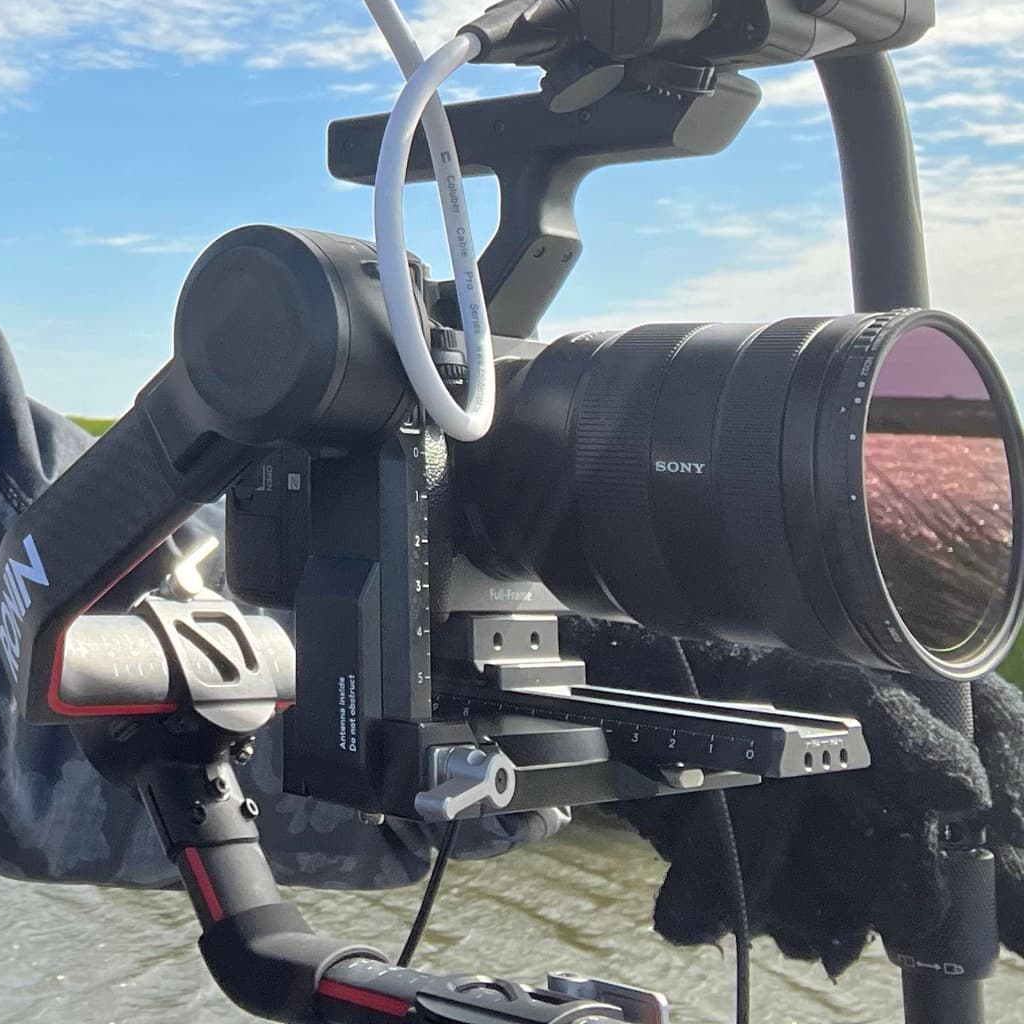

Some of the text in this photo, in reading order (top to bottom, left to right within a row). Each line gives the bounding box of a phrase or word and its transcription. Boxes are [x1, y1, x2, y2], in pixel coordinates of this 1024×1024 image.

[456, 227, 467, 257] Cable
[464, 271, 475, 290] Pro
[413, 448, 419, 458] 0
[655, 461, 706, 474] SONY
[414, 491, 419, 503] 1
[414, 536, 421, 547] 2
[415, 580, 422, 592] 3
[0, 533, 50, 684] RONIN
[416, 627, 423, 637] 4
[417, 672, 424, 684] 5
[348, 674, 356, 716] obstruct
[349, 737, 357, 752] Do
[631, 733, 639, 743] 3
[668, 738, 677, 748] 2
[709, 743, 713, 753] 1
[745, 748, 754, 759] 0
